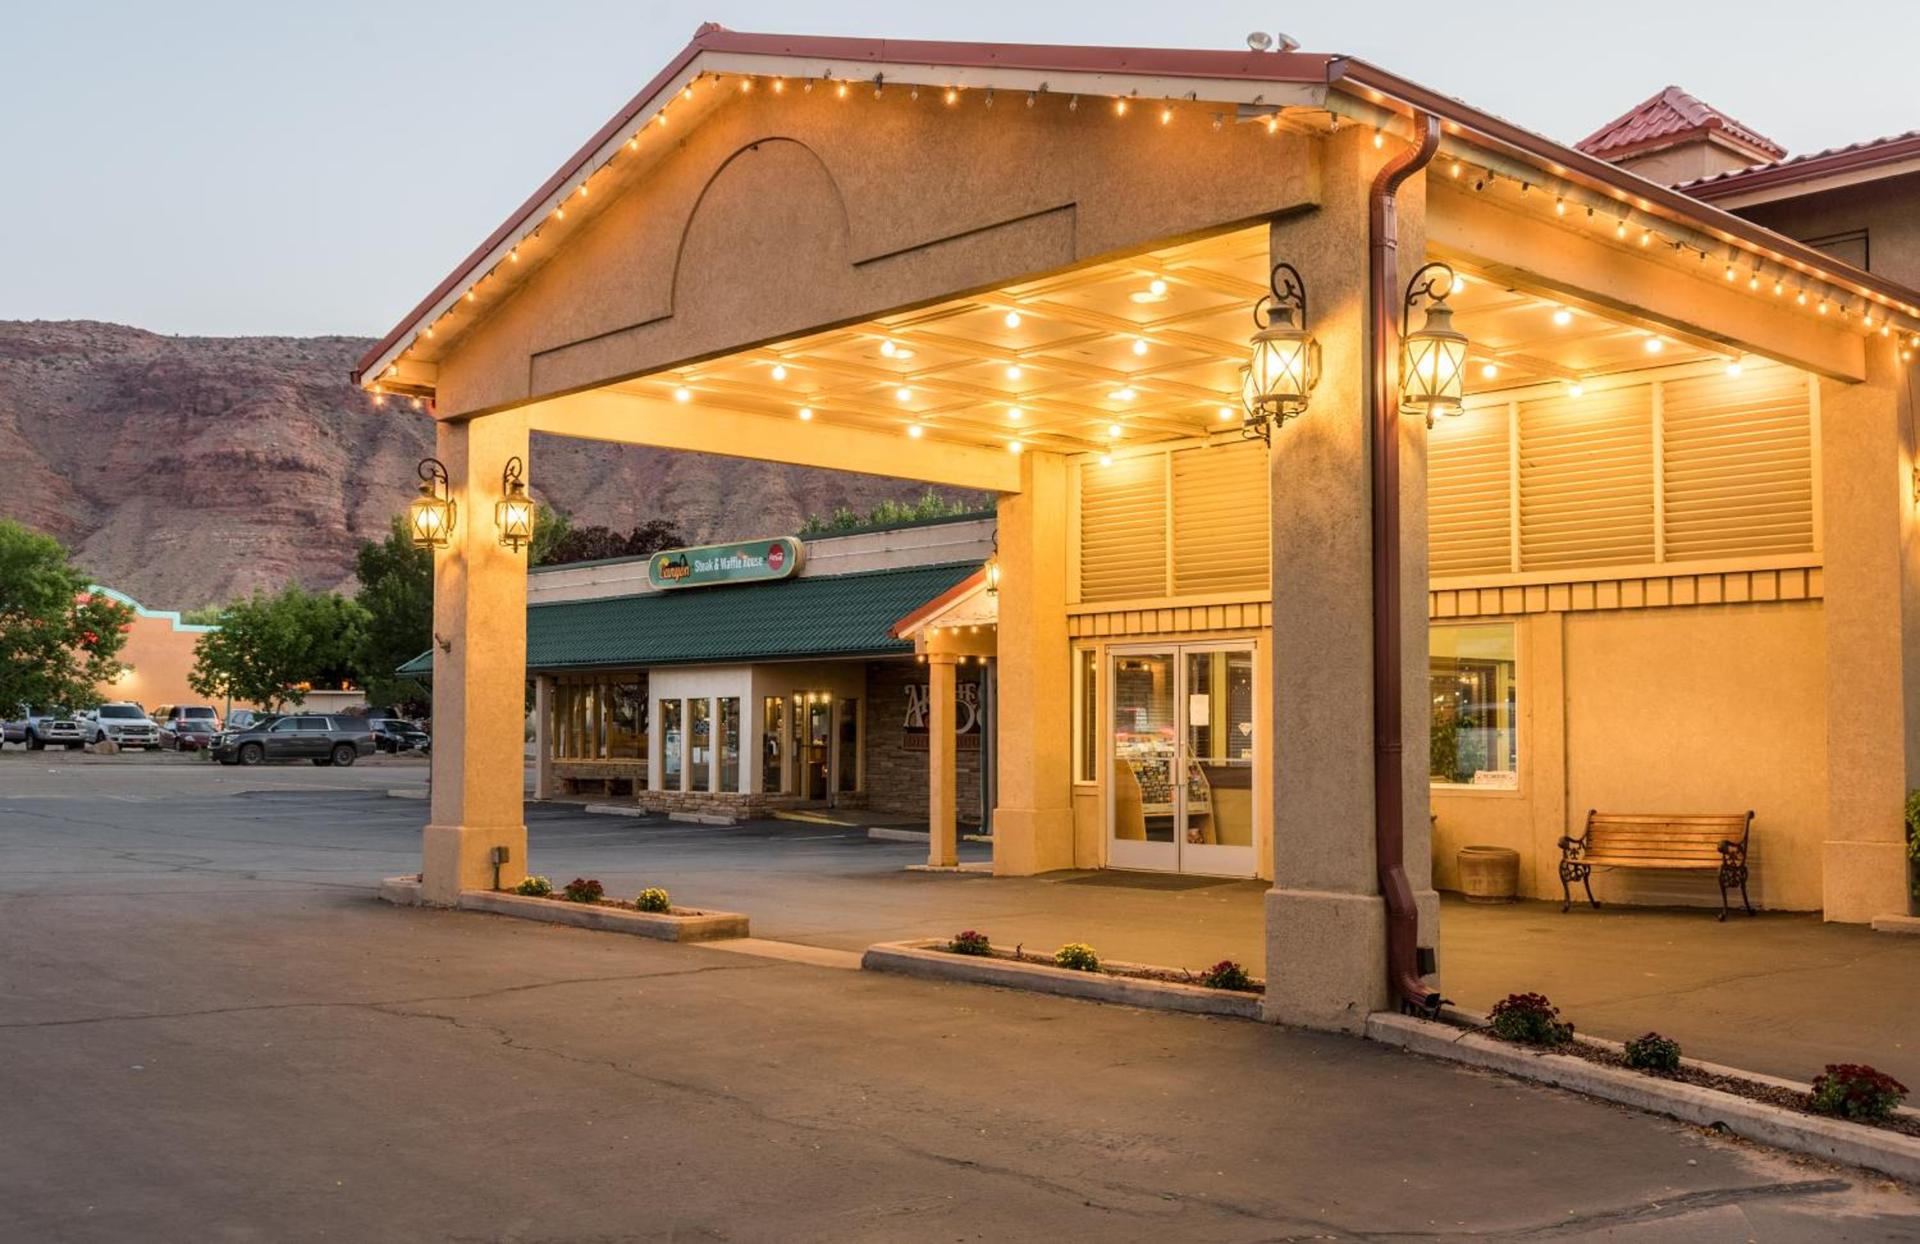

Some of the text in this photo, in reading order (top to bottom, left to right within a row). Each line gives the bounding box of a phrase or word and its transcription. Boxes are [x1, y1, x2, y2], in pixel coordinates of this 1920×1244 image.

[694, 560, 713, 573] Steak
[714, 558, 720, 571] &
[720, 556, 742, 570] Waffle
